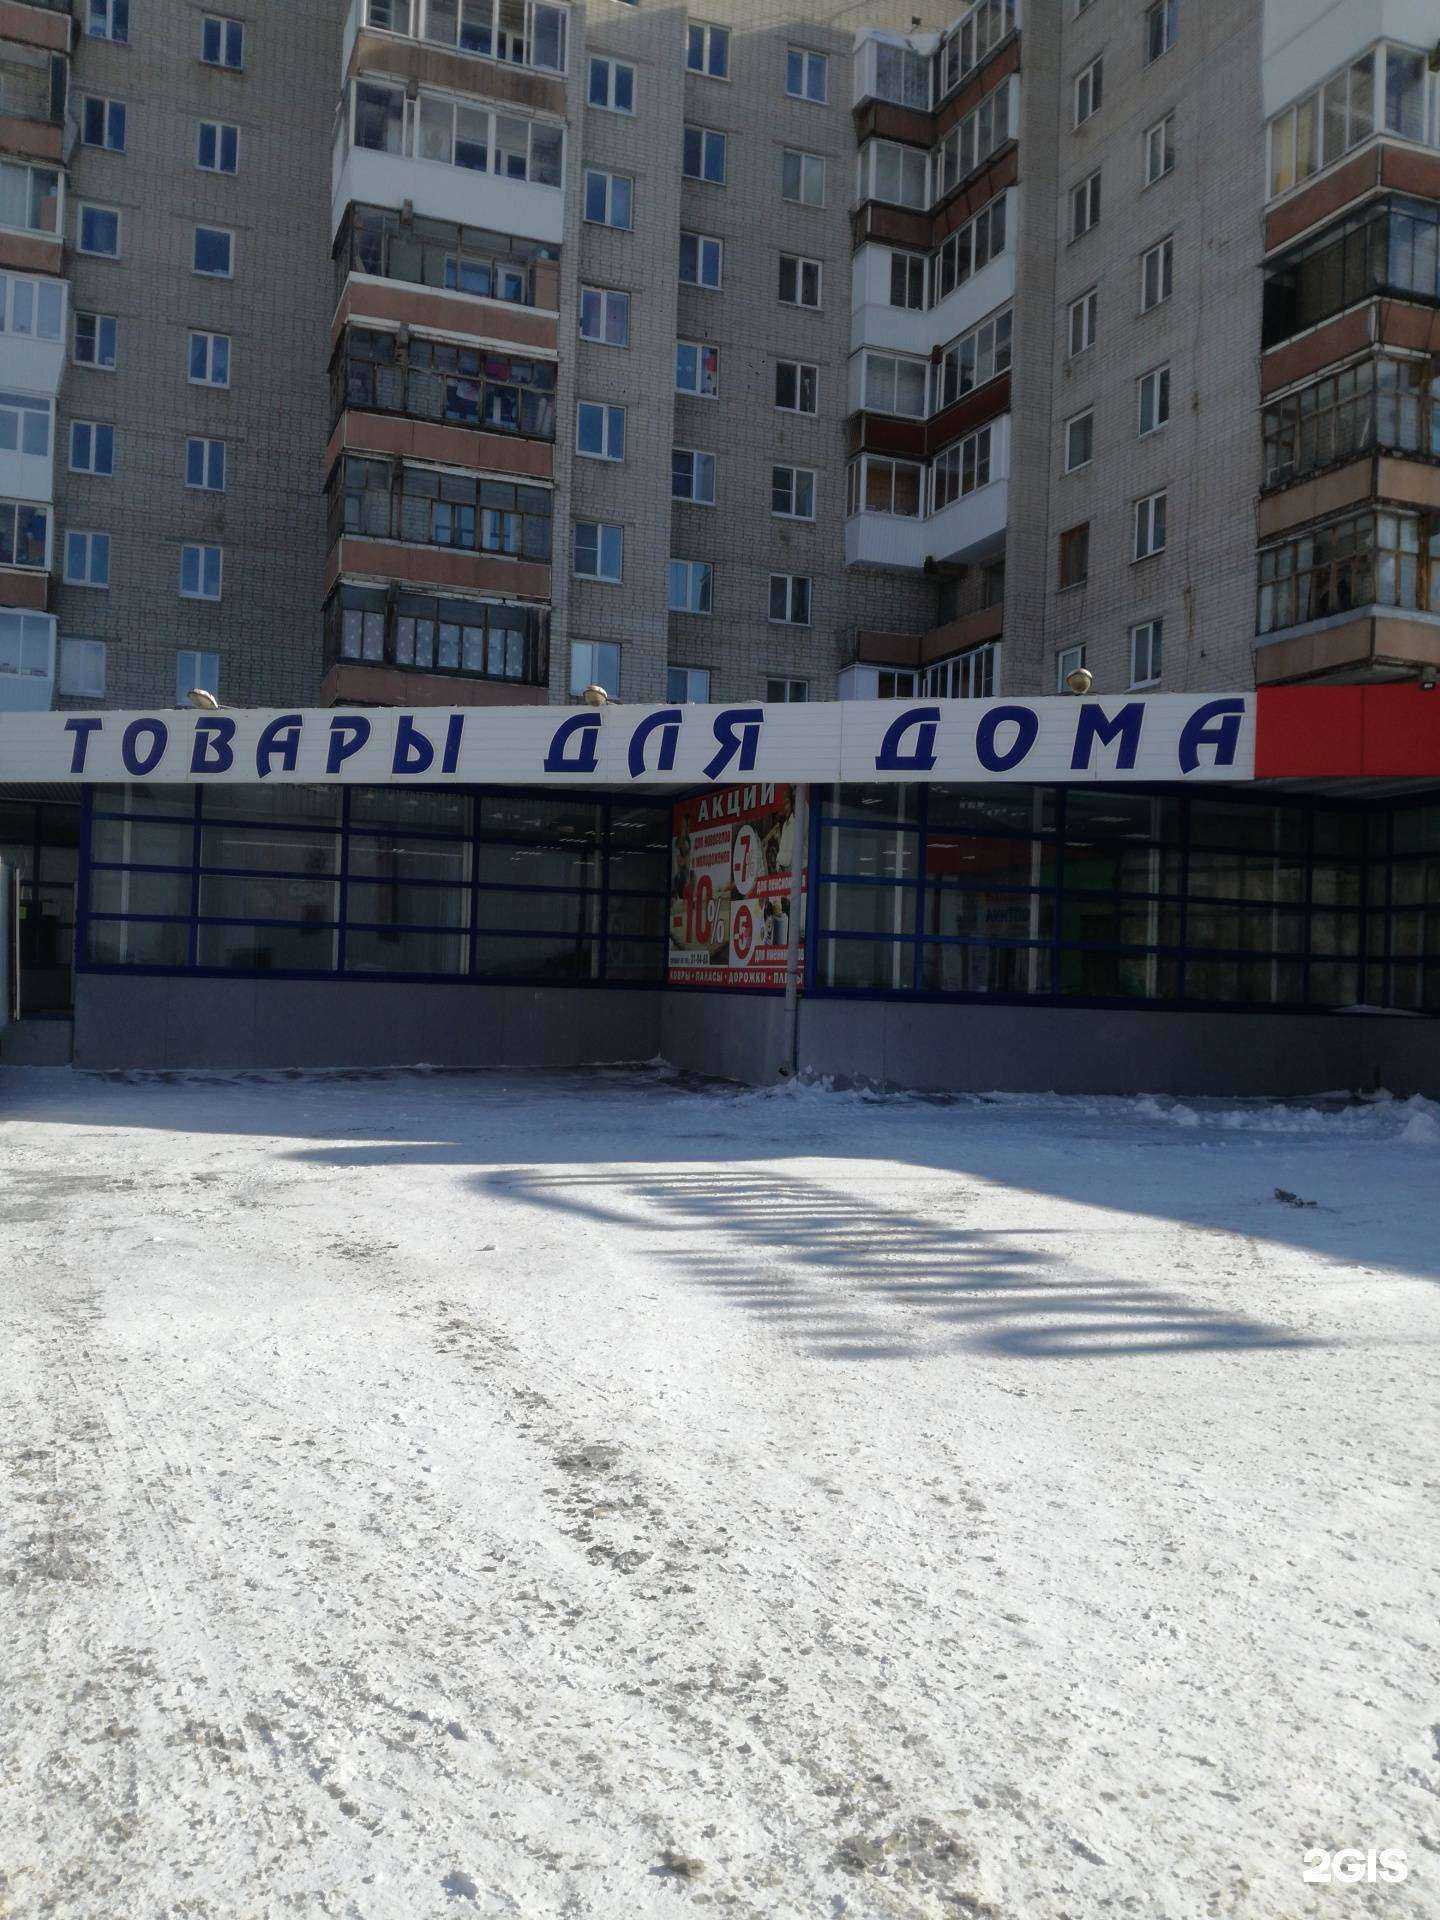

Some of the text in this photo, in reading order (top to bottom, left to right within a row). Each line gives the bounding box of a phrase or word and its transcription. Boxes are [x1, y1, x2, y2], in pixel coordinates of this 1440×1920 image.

[65, 697, 1246, 782] ТОВАРЫ ДЛЯ ДОМА
[698, 783, 776, 822] АКЦИИ
[728, 971, 766, 985] ДОРОЖКИ
